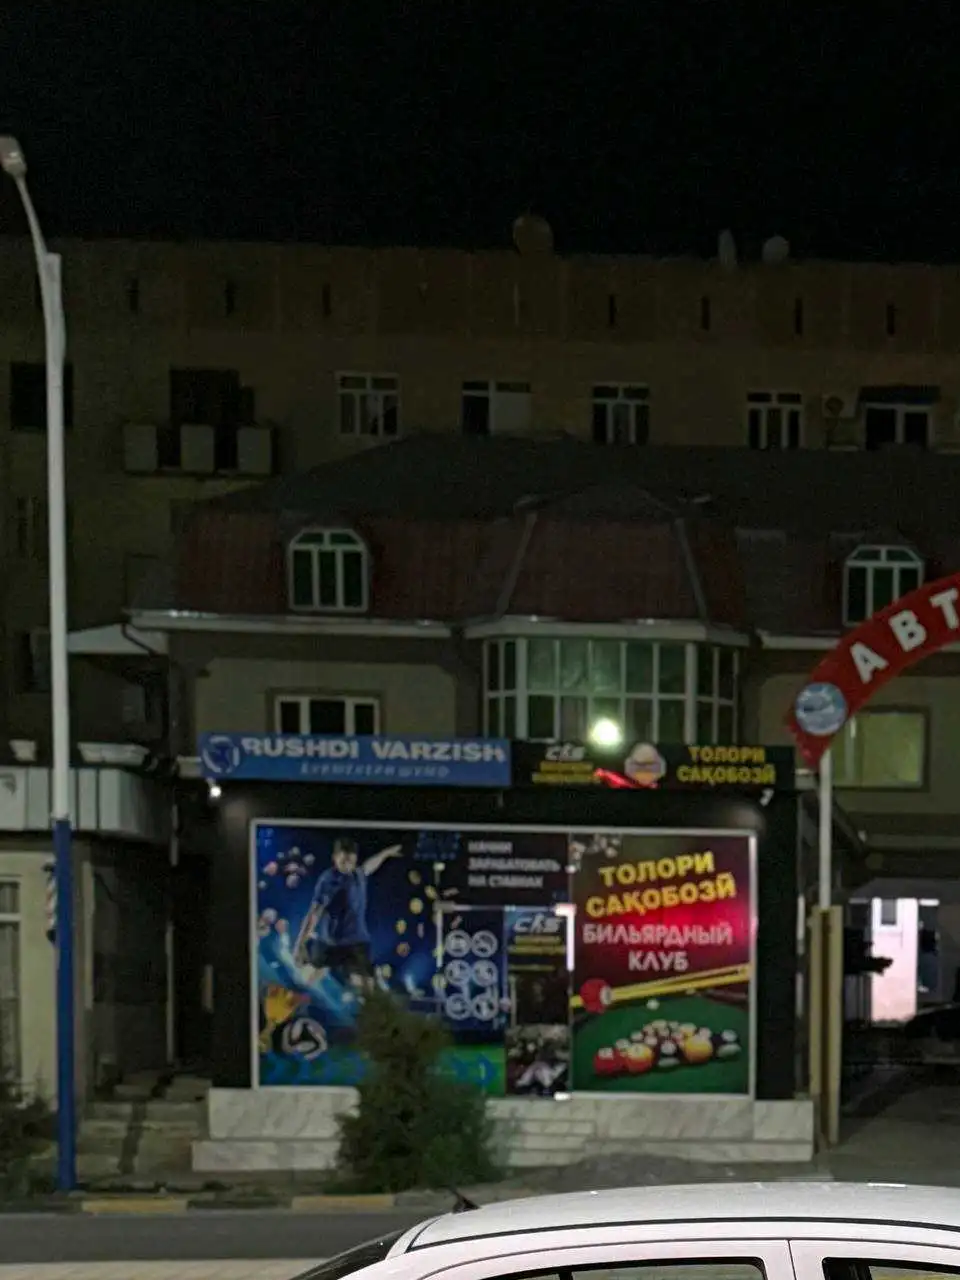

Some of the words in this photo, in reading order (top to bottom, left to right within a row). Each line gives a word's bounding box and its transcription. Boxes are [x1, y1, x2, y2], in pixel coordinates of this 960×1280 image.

[240, 737, 360, 759] RUSHDI
[371, 739, 507, 763] VARZISH
[688, 745, 766, 763] ТОЛОРИ
[598, 850, 716, 888] ТОЛОРИ
[582, 920, 733, 948] БИЛЬЯРДНЫЙ
[628, 950, 690, 972] КЛУБ
